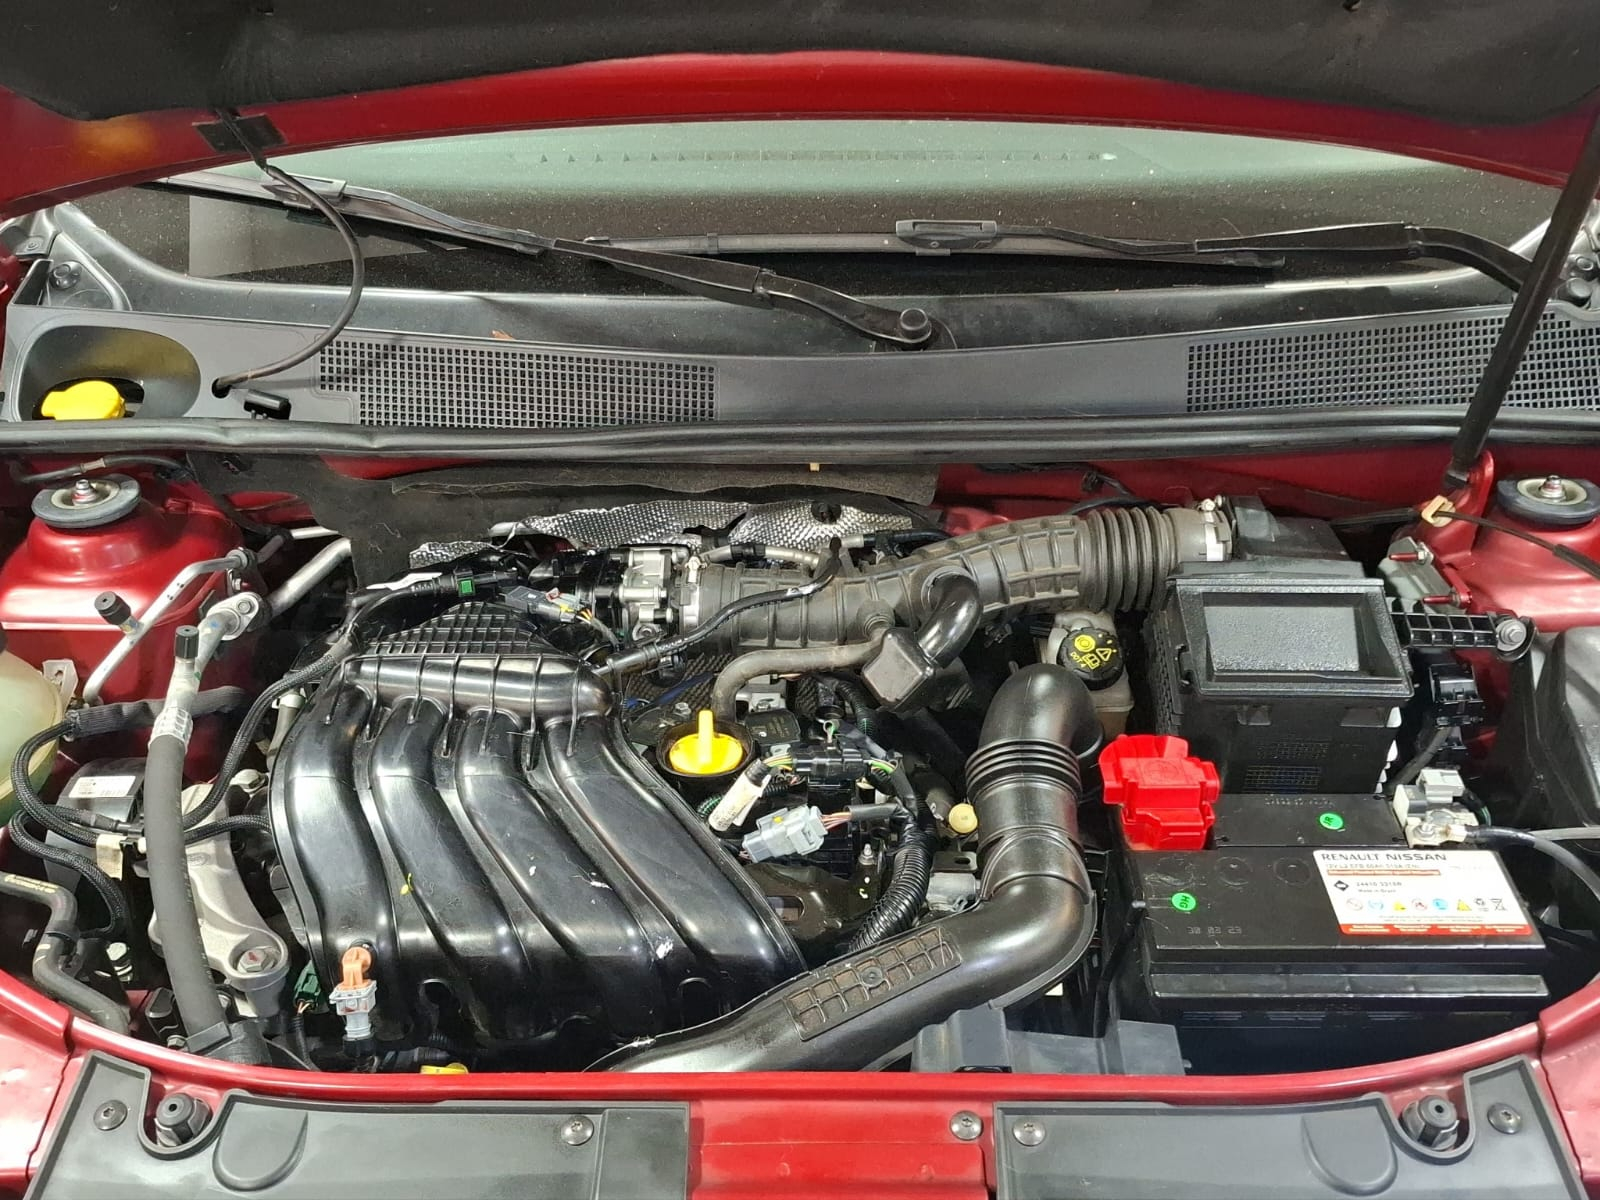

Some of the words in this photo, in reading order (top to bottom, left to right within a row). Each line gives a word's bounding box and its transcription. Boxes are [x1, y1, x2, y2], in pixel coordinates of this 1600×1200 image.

[1322, 816, 1334, 826] JR
[1320, 853, 1380, 861] RENAULT
[1385, 853, 1447, 861] NISSAN
